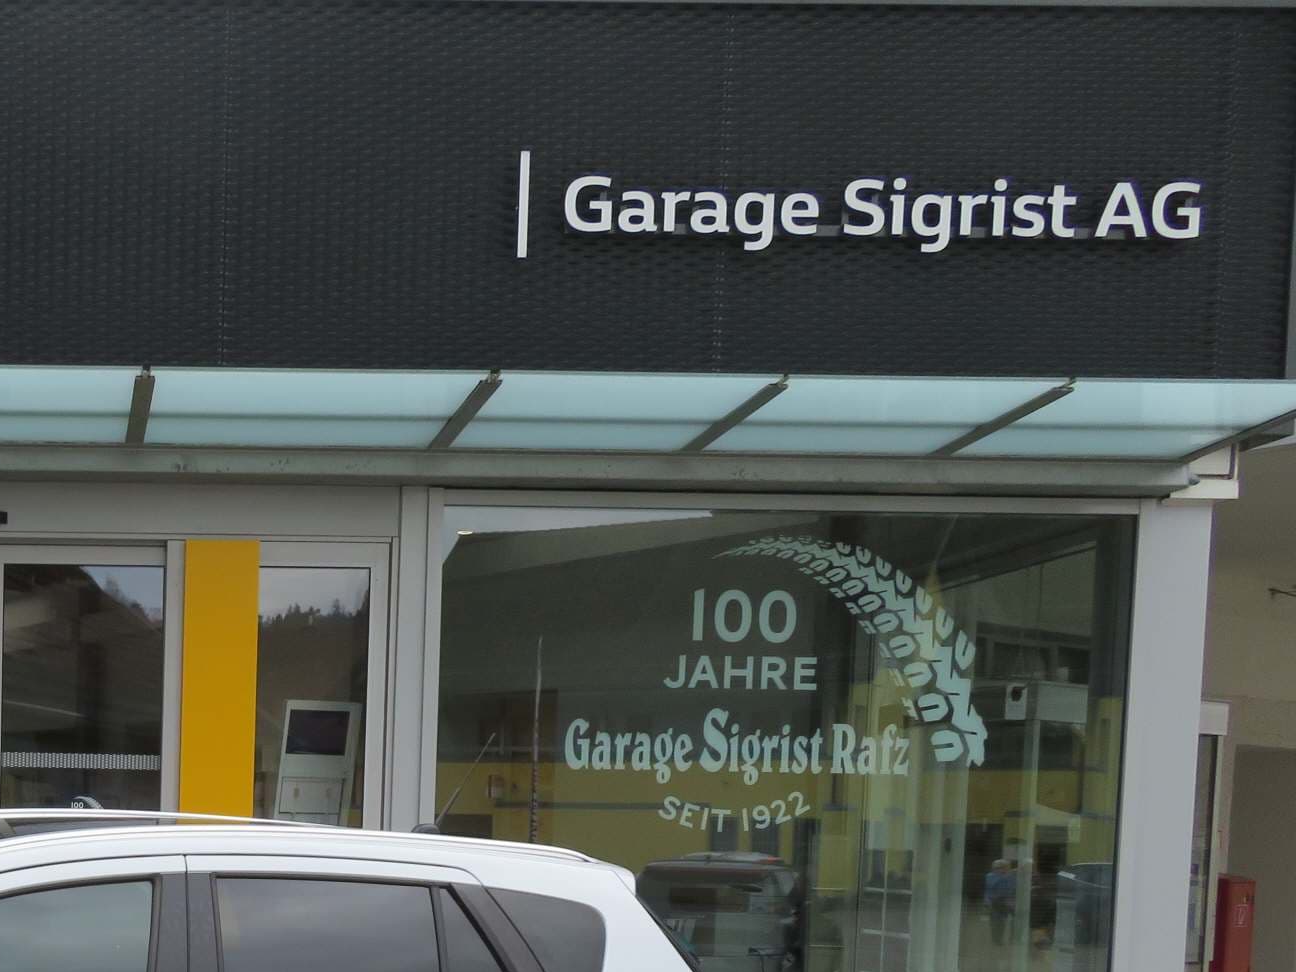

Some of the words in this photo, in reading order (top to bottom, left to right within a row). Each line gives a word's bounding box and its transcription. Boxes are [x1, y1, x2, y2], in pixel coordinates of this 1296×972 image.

[564, 175, 820, 251] Garage
[842, 177, 1077, 253] Sigrist
[1094, 182, 1202, 240] AG
[692, 588, 798, 643] 100
[664, 655, 818, 691] JAHRE
[564, 718, 694, 784] Garage
[699, 708, 823, 785] Sigrist
[830, 723, 910, 776] Rafz
[658, 795, 732, 832] SEIT
[742, 791, 811, 832] 1922
